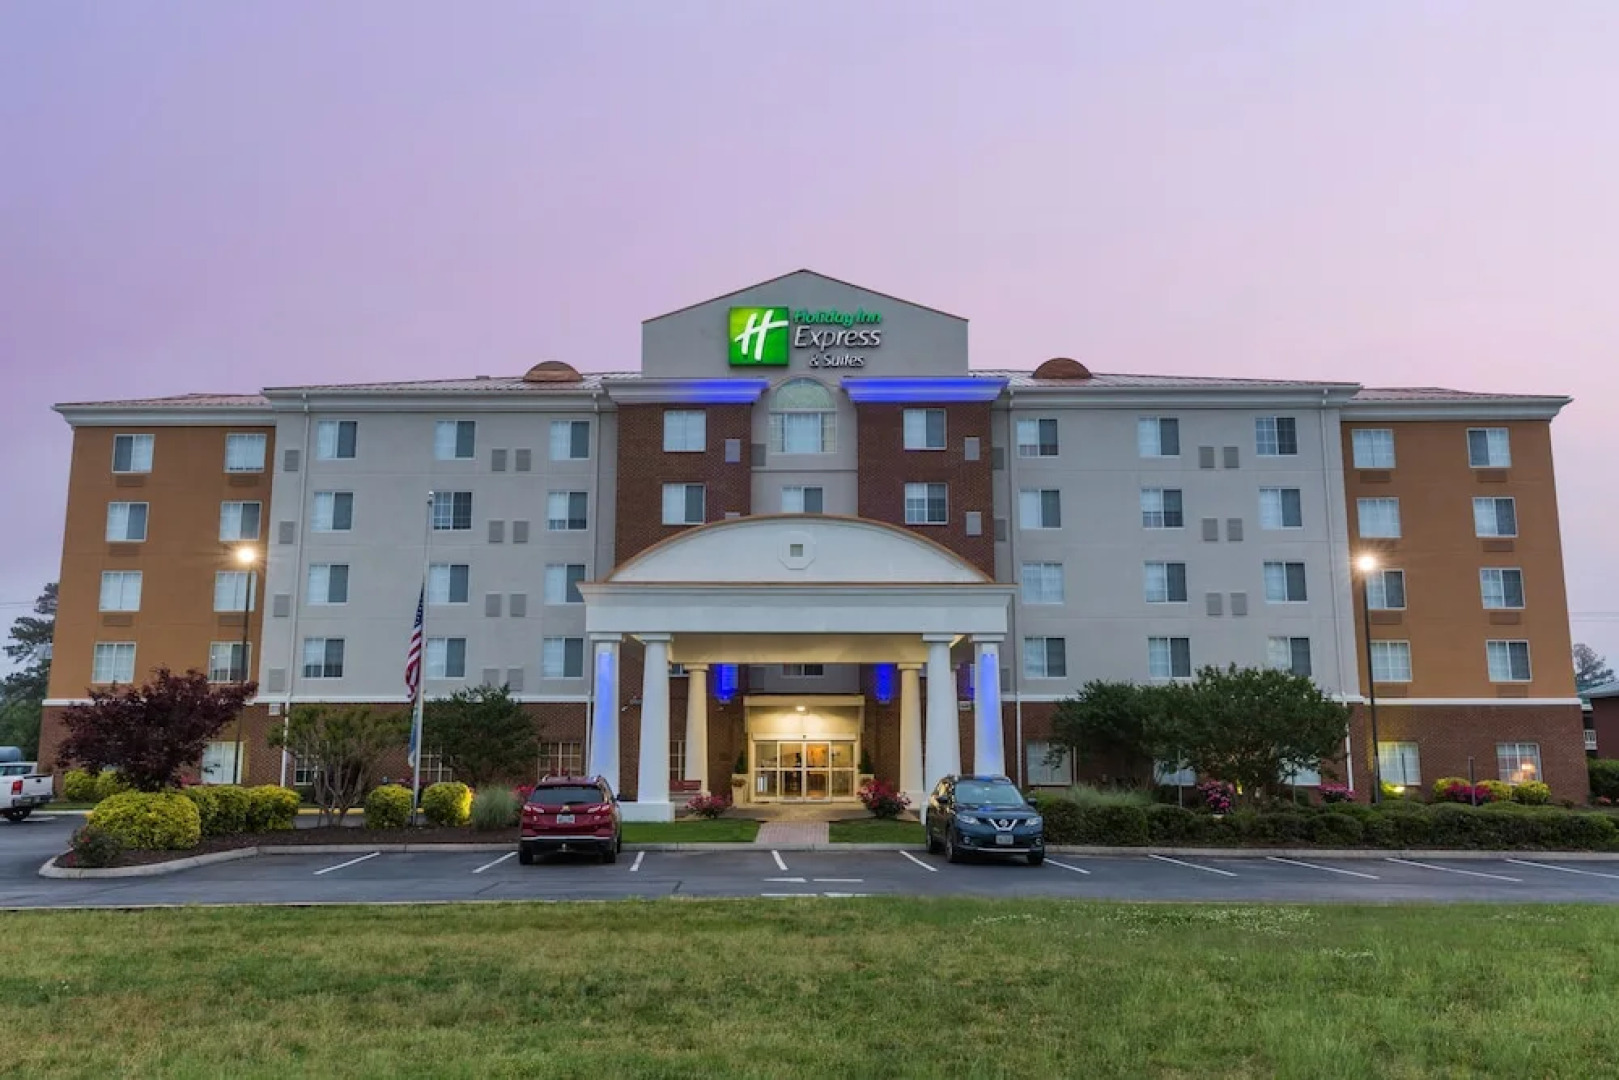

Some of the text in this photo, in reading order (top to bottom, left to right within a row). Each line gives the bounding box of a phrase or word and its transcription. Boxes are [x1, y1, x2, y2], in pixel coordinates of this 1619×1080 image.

[793, 307, 882, 327] Holiday Inn
[794, 325, 882, 351] Express
[809, 353, 864, 367] & Suites
